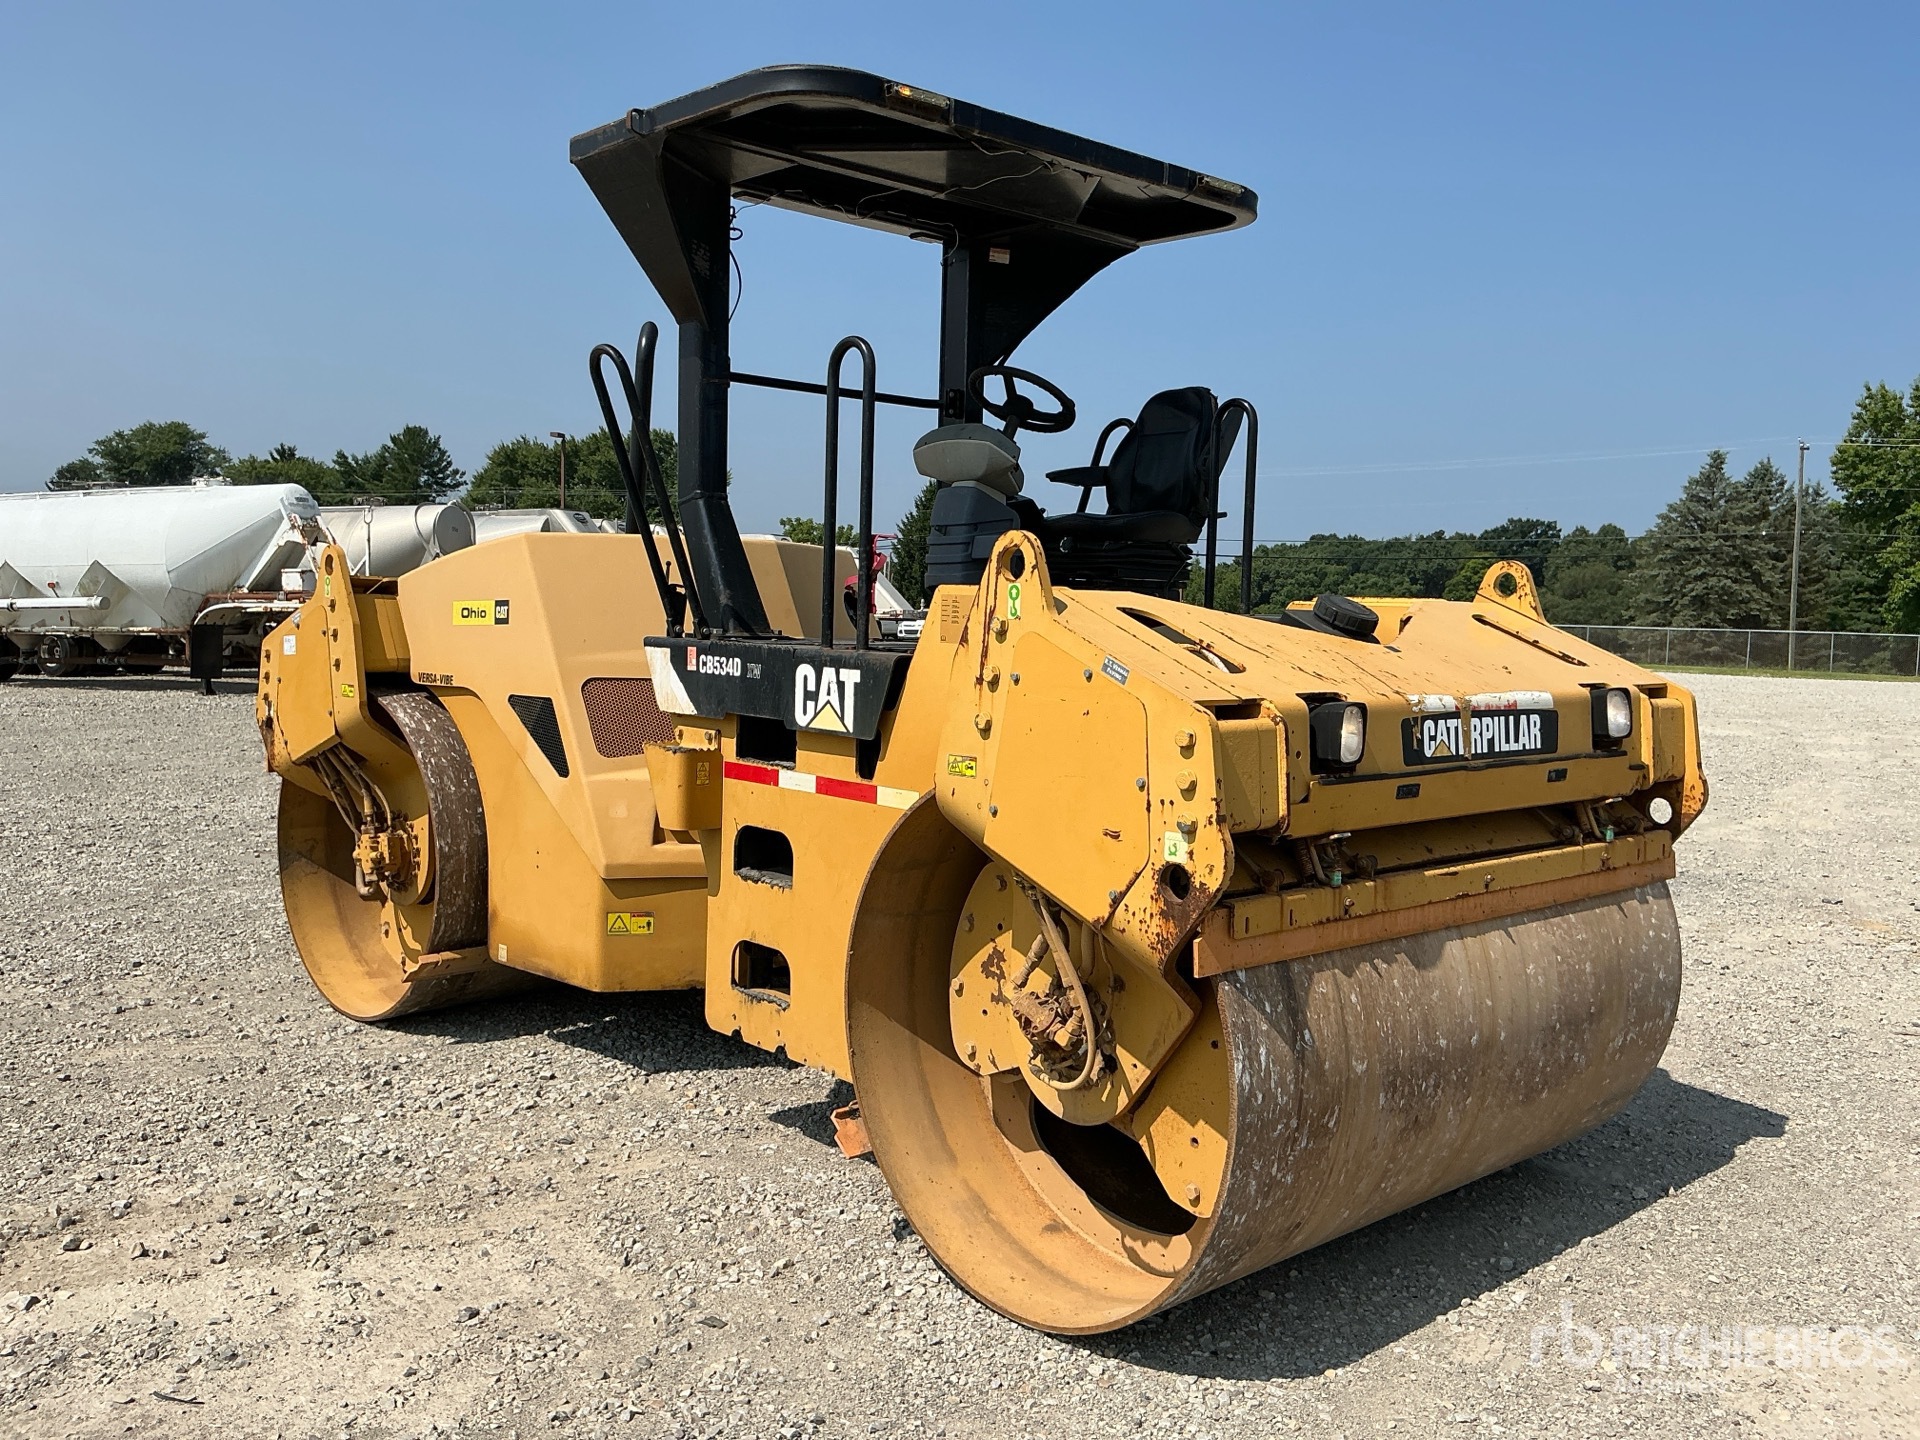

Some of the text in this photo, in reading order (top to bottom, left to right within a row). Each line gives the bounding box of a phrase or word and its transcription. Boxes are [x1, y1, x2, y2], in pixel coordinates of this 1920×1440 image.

[461, 607, 487, 619] Ohio
[495, 606, 508, 619] CAT
[699, 654, 741, 677] CB534D
[418, 672, 454, 685] VERSA-VIBE
[795, 663, 861, 733] CAT
